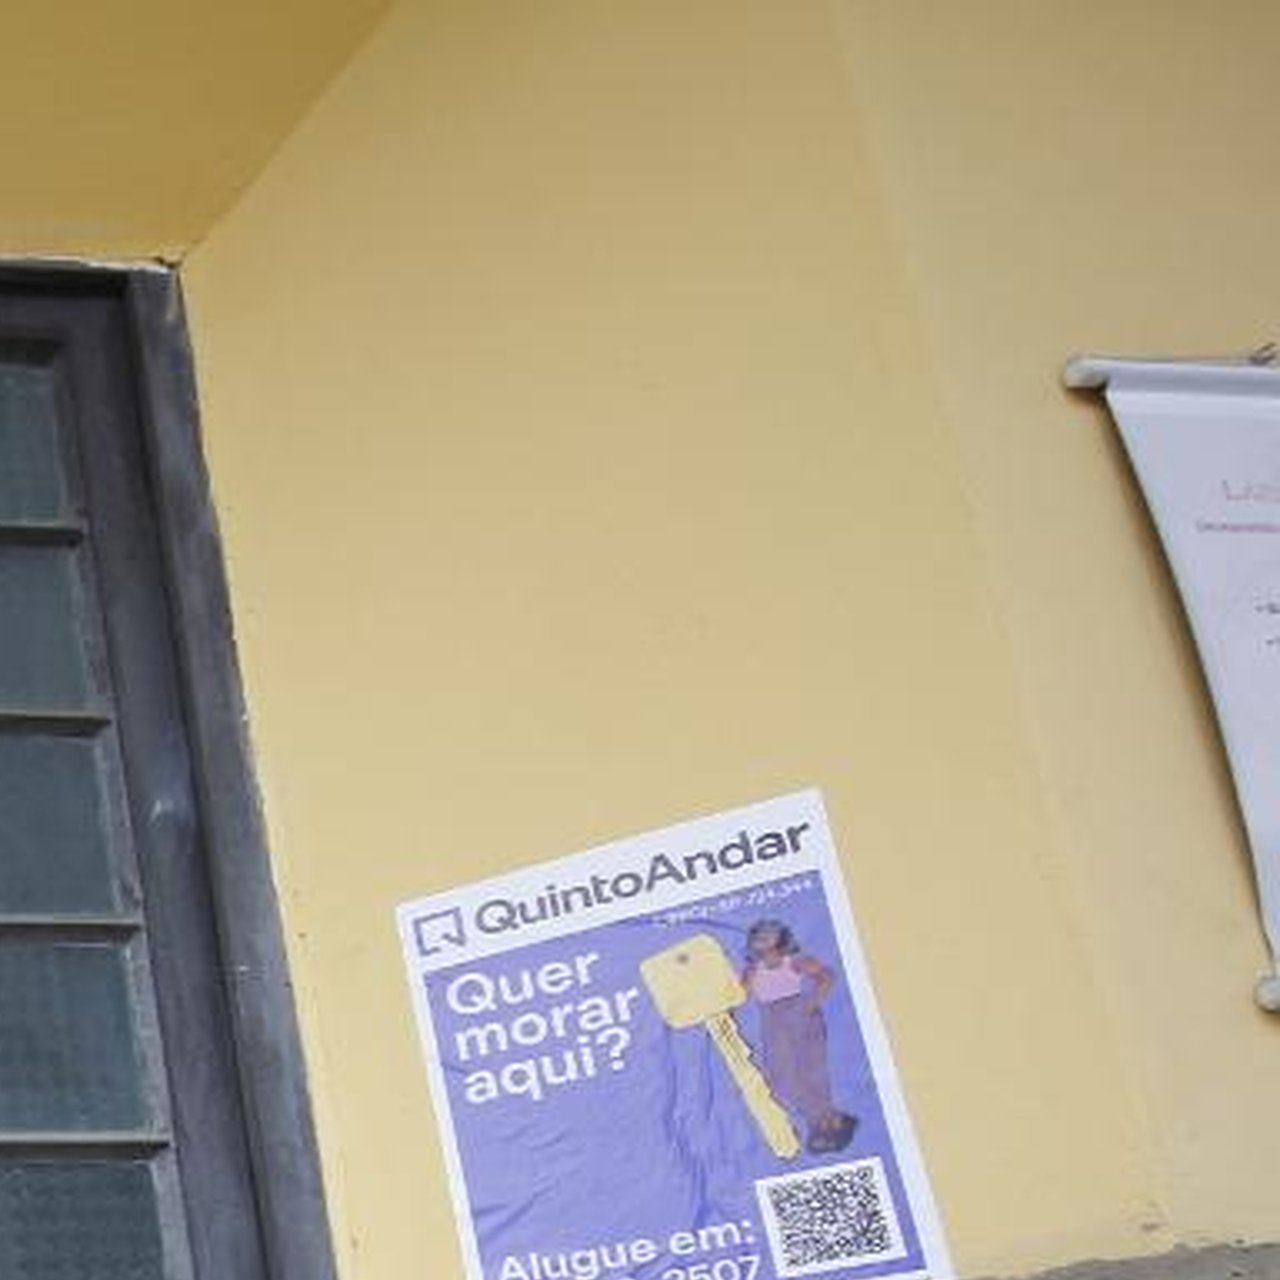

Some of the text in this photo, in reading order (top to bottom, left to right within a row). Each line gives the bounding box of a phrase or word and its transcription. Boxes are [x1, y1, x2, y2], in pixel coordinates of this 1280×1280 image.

[474, 821, 811, 935] QuintoAndar
[446, 953, 600, 1014] Quer
[455, 986, 639, 1061] morar
[464, 1026, 630, 1104] aqui?
[669, 1219, 753, 1255] em:
